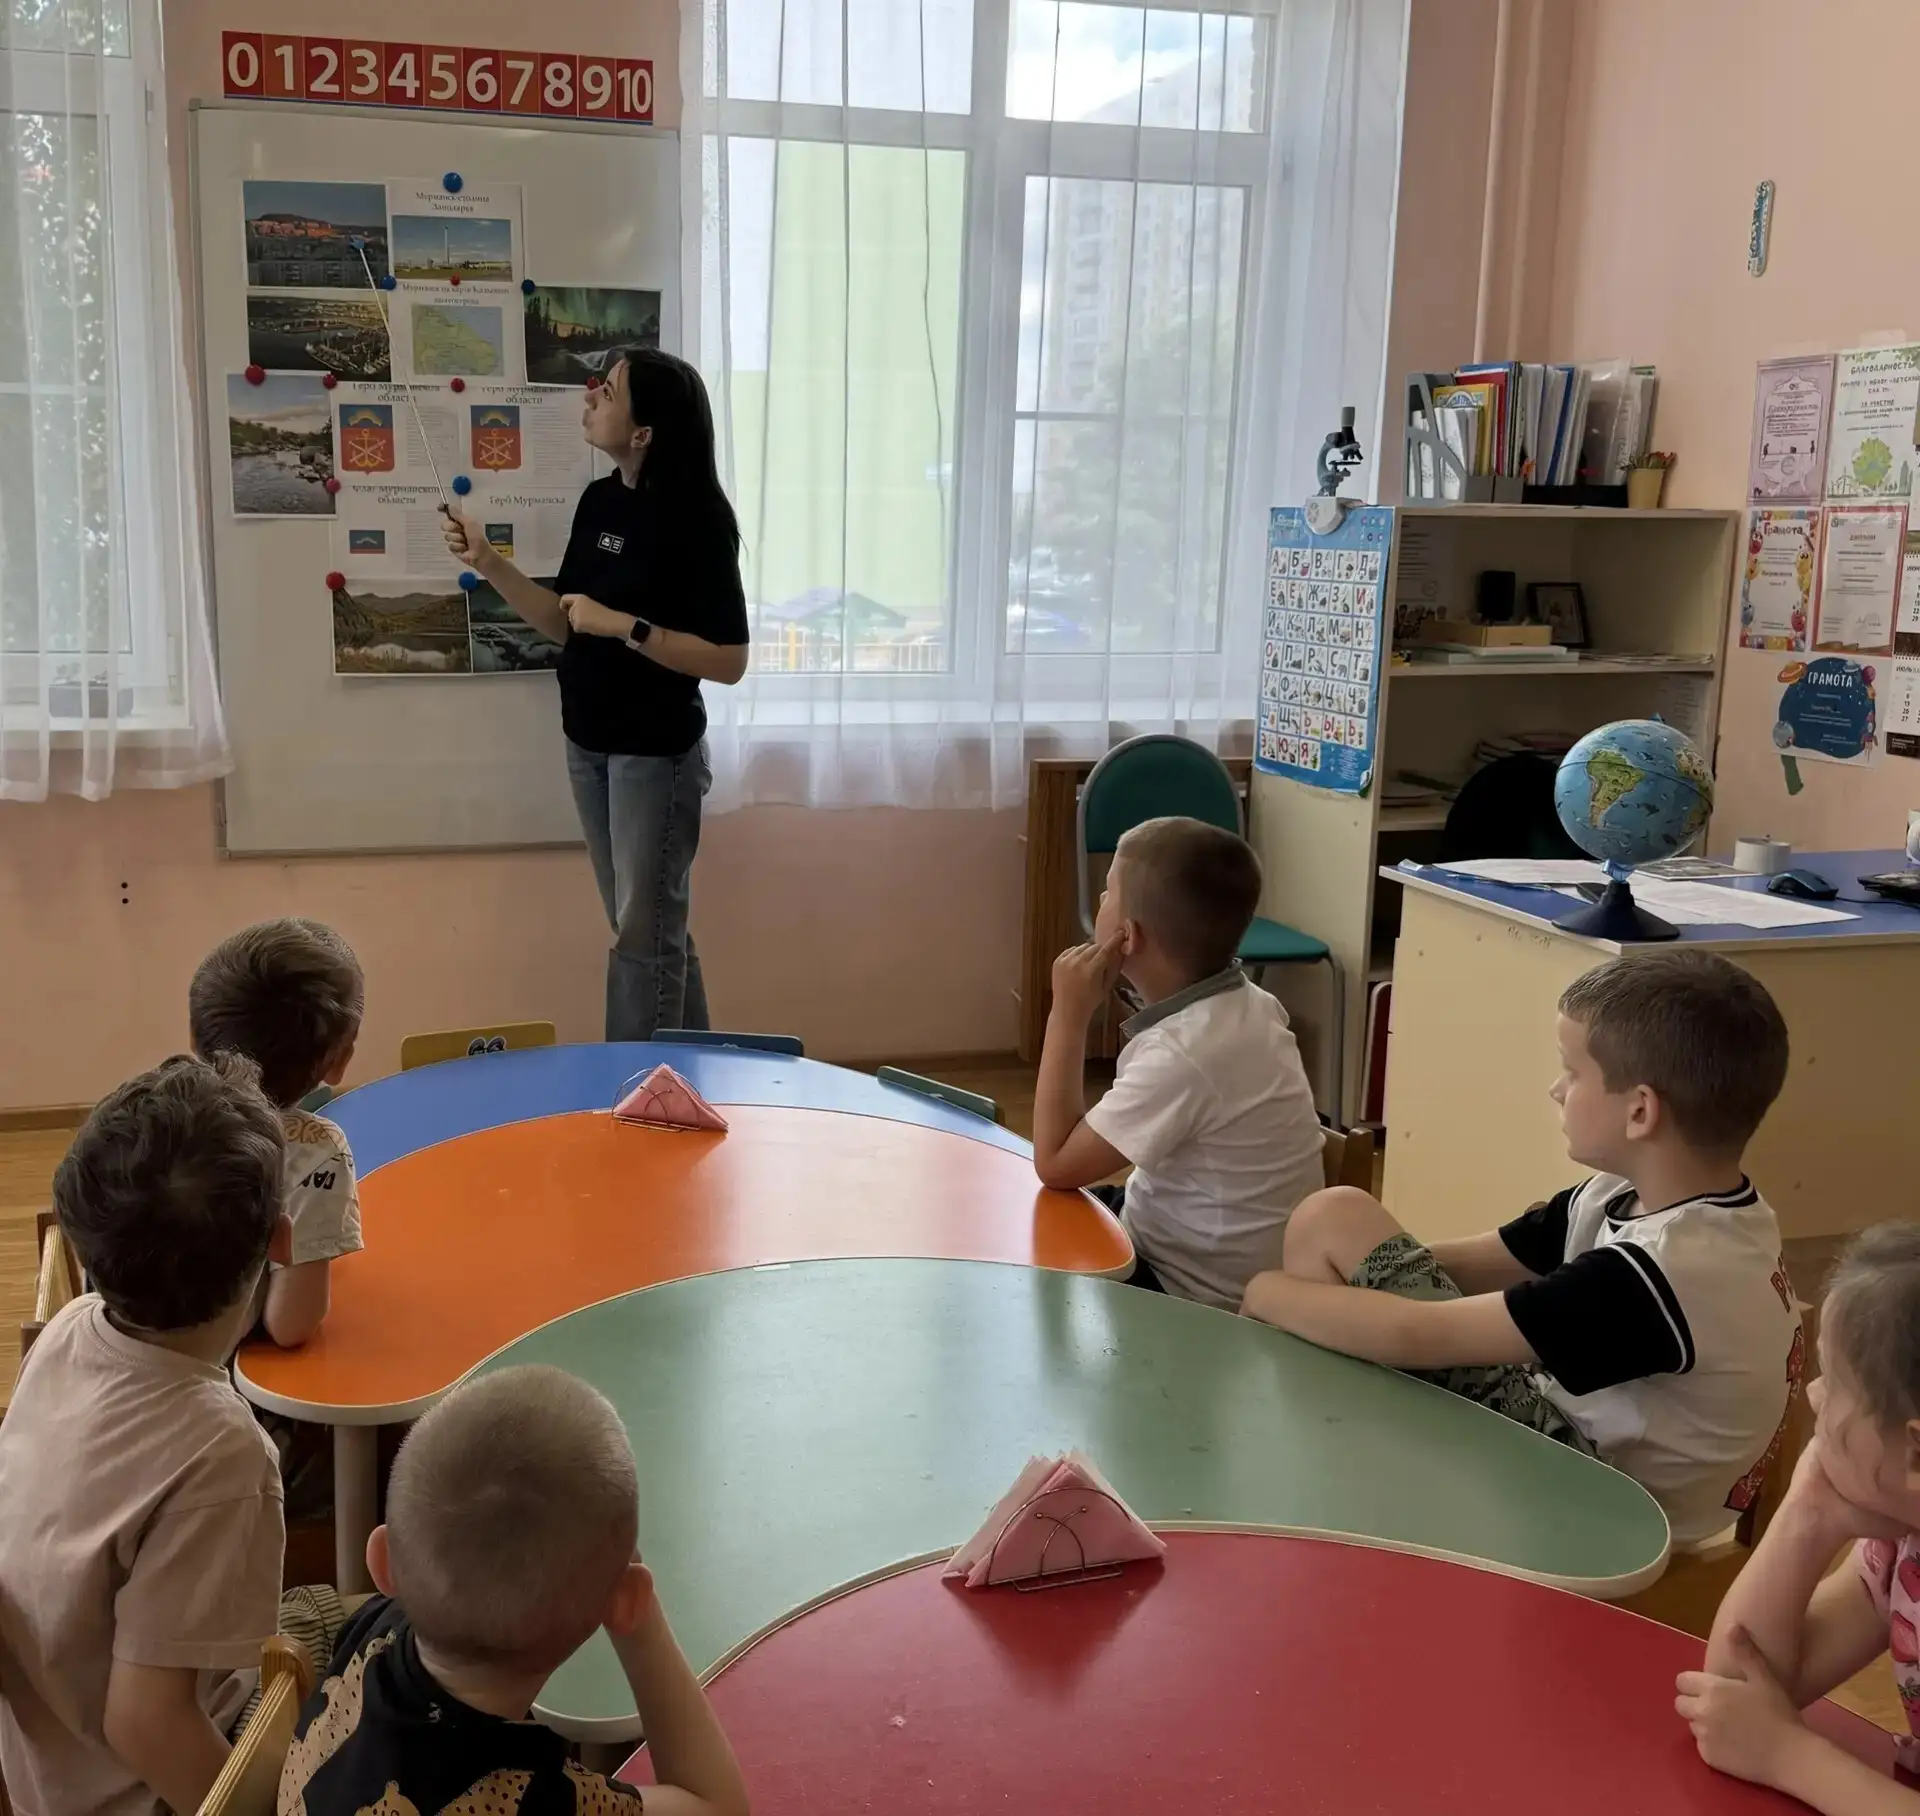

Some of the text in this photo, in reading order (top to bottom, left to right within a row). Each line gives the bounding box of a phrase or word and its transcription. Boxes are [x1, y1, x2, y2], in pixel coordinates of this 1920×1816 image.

[228, 42, 652, 113] 0 1 2 3 4 5 6 7 8 9 10
[489, 495, 513, 508] Герб
[1764, 522, 1803, 536] Грамота
[1272, 551, 1368, 575] А Б В Г Д
[1270, 582, 1276, 597] Е
[1308, 584, 1319, 601] Ж
[1332, 586, 1339, 602] З
[1356, 588, 1366, 604] И
[1287, 613, 1295, 630] К
[1307, 617, 1316, 632] Л
[1328, 619, 1339, 635] М
[1355, 621, 1364, 638] Н
[1266, 642, 1362, 670] О П Р С Т
[1264, 673, 1356, 704] У Ф Х Ц Ч
[1808, 671, 1853, 688] ГРАМОТА
[1279, 707, 1290, 727] Щ
[1324, 715, 1334, 731] Ы
[1348, 720, 1356, 736] Ь
[1278, 737, 1289, 753] Ю
[1301, 743, 1309, 758] Я
